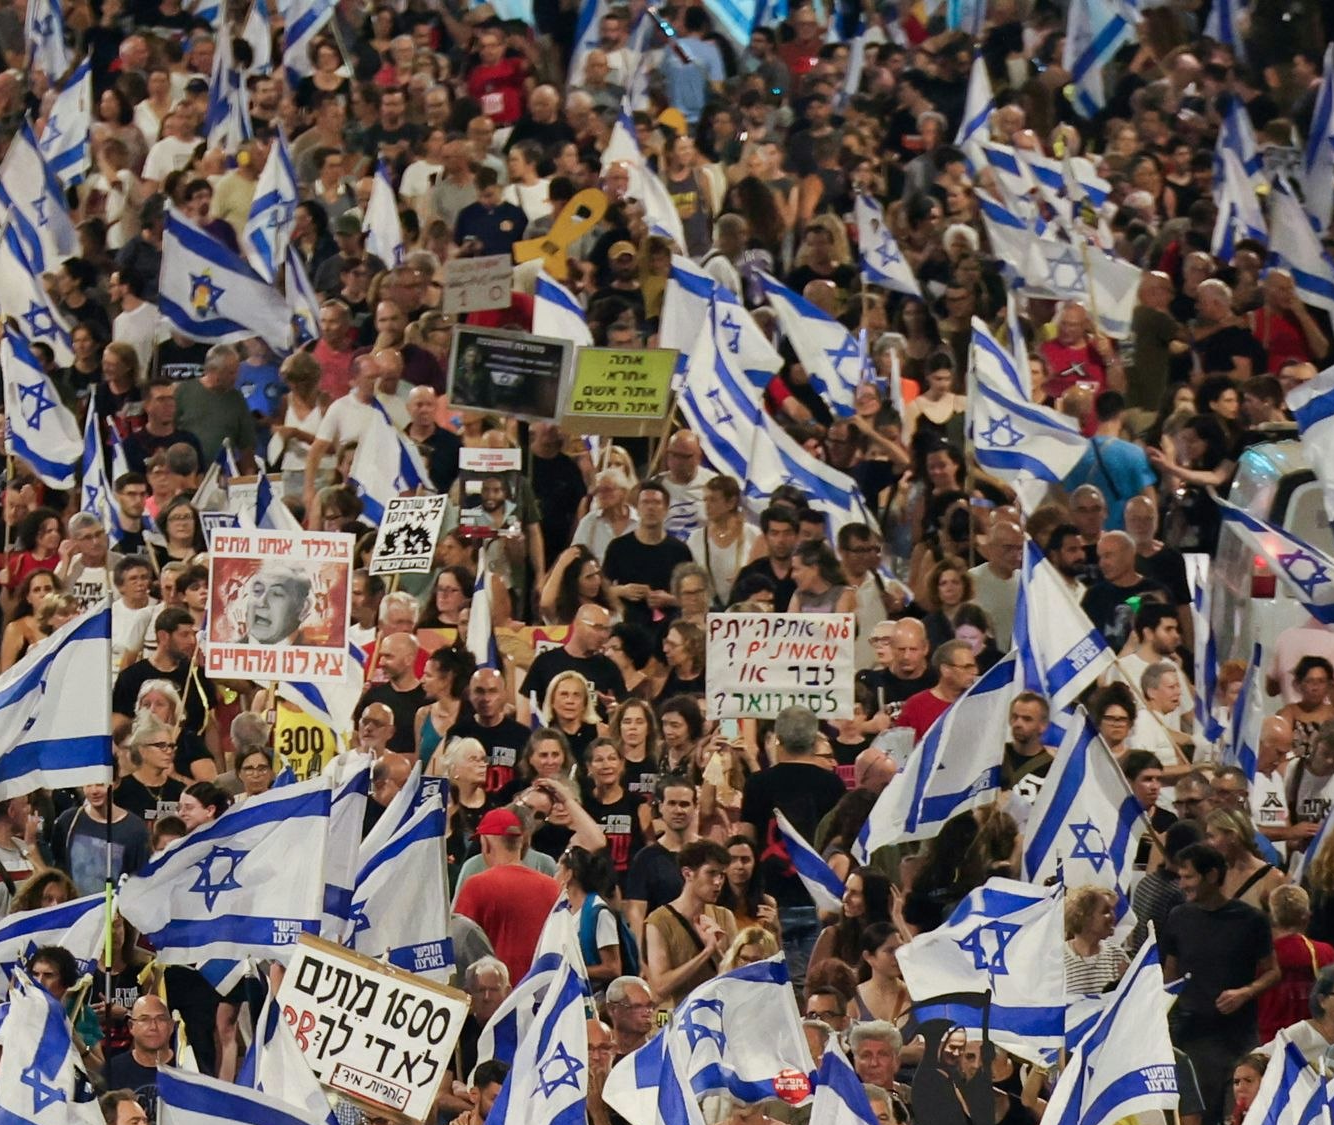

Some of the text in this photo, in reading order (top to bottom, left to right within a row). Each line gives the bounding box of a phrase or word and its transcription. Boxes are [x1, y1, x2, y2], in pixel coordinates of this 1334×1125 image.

[214, 536, 349, 559] בגללך אנחנו מתים
[209, 647, 345, 677] צא לנו מהחיים
[279, 726, 325, 756] 300
[412, 943, 443, 958] חופשי
[413, 956, 446, 970] בארצנו
[295, 955, 452, 1043] 1600 מתים
[1139, 1065, 1176, 1079] חופשי
